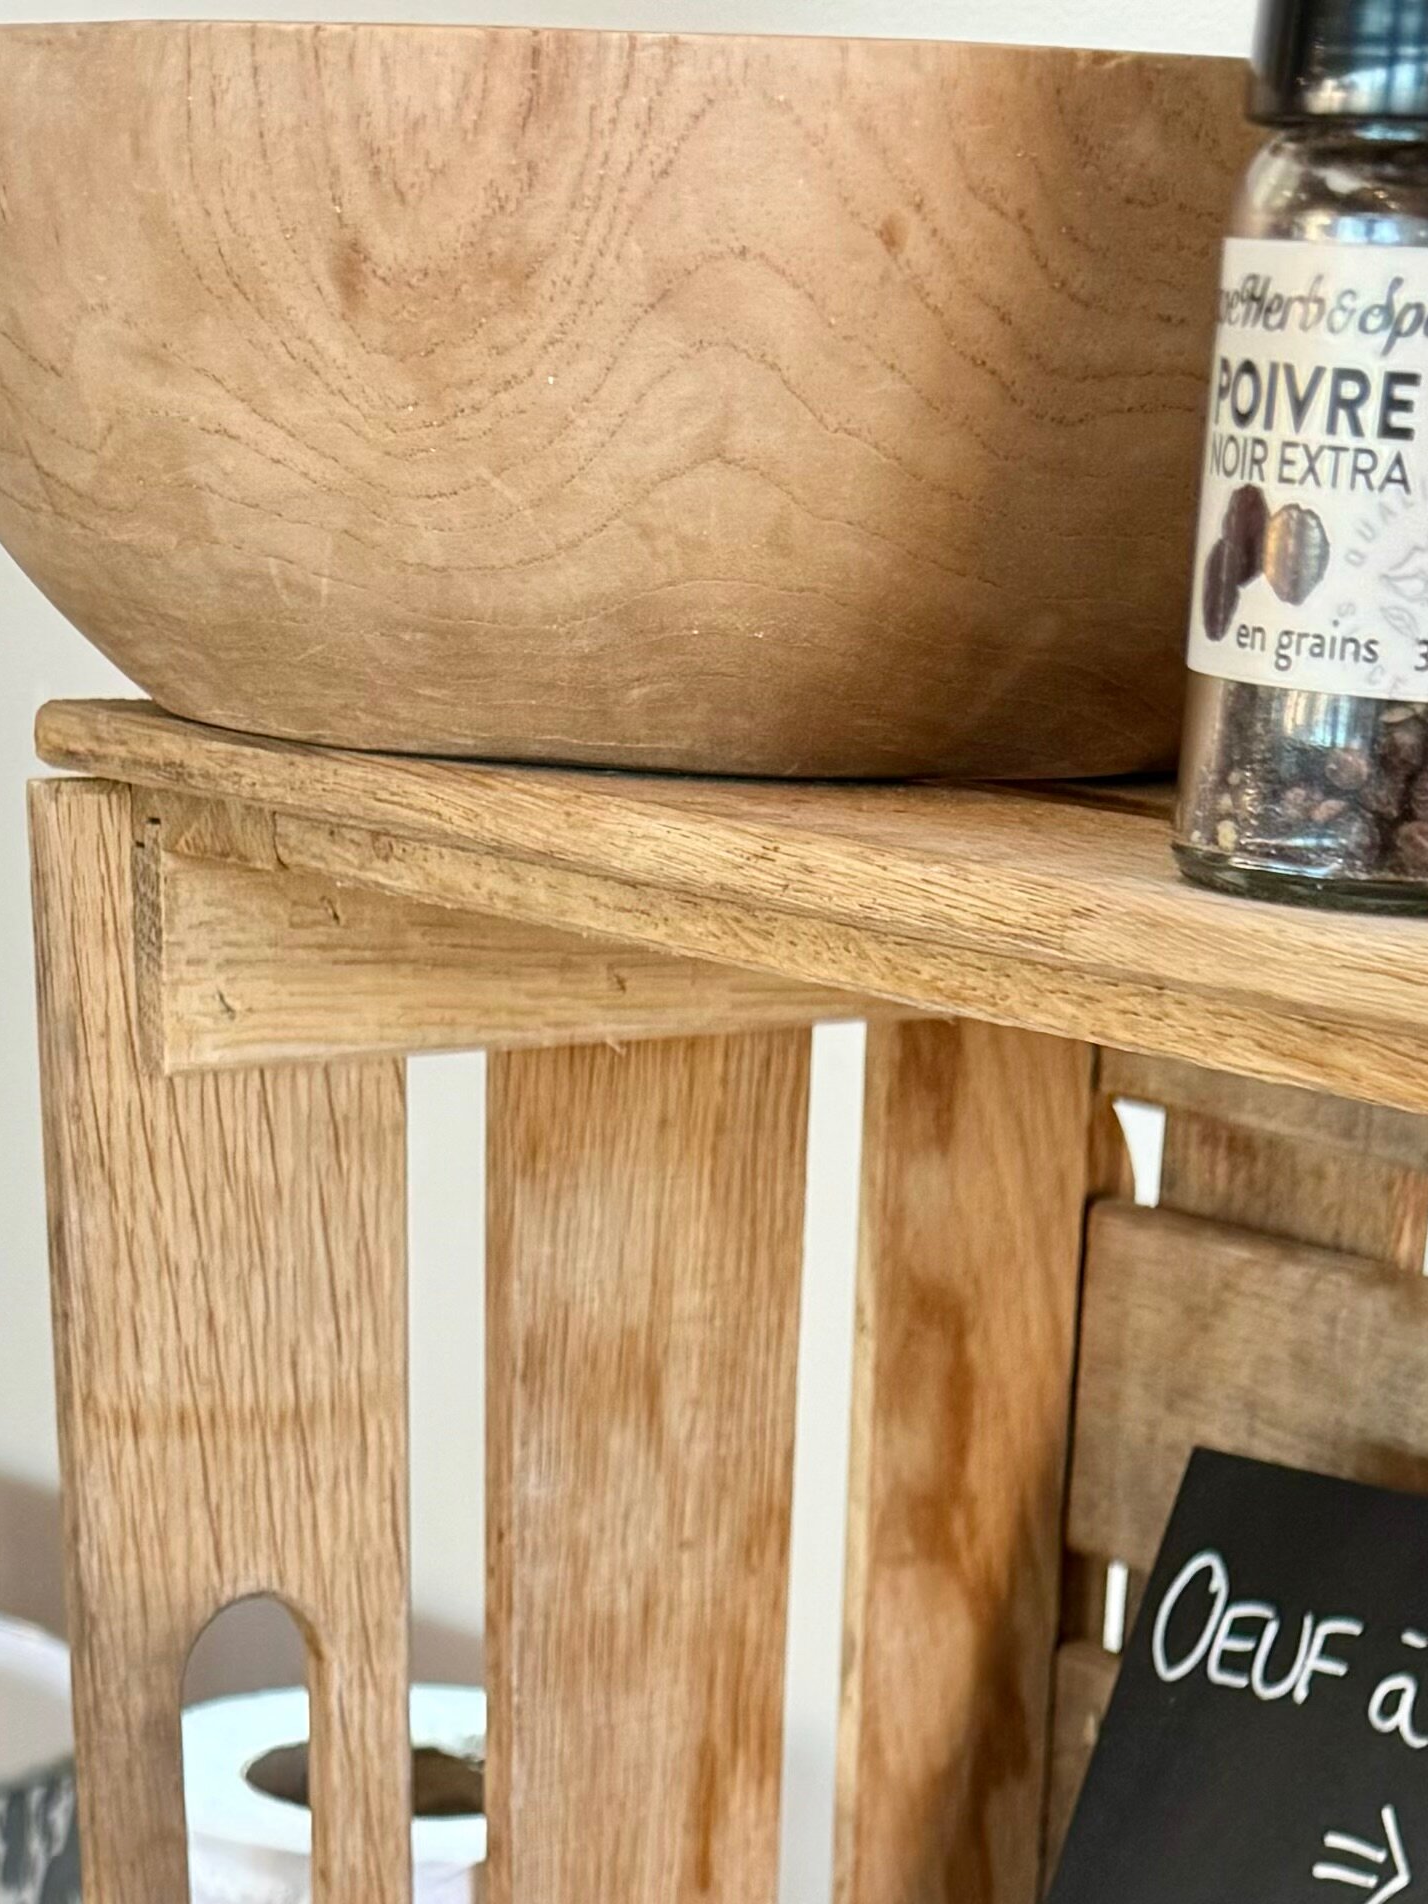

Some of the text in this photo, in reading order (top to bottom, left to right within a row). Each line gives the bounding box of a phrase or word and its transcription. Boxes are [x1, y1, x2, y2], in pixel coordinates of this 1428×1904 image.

[1213, 358, 1423, 442] POIVRE
[1210, 433, 1412, 496] NOIR EXTRA
[1235, 622, 1267, 652] en
[1273, 618, 1380, 672] grains
